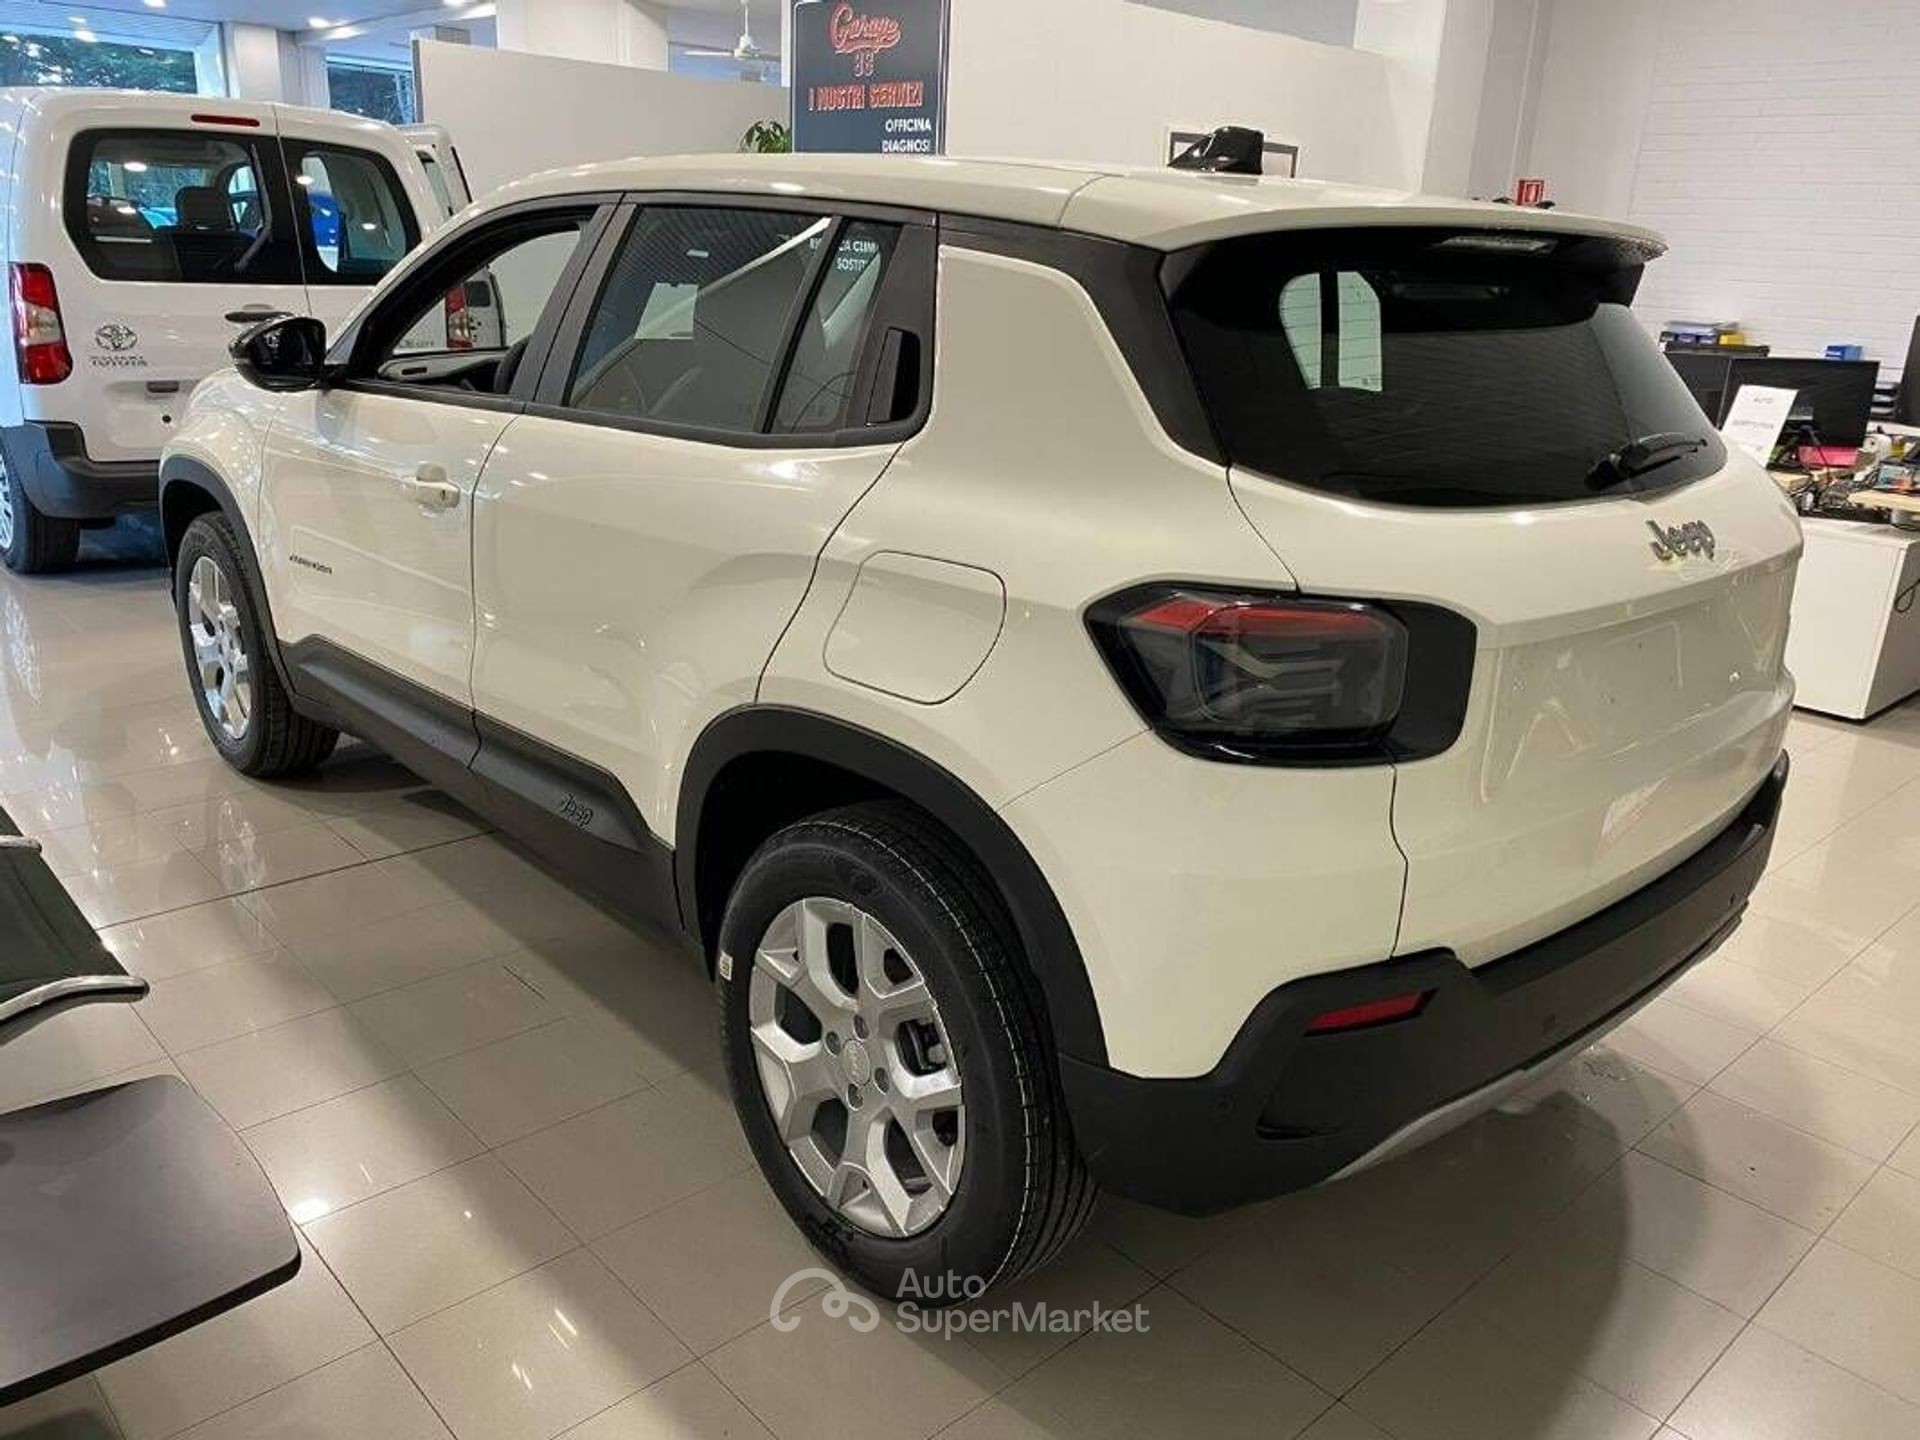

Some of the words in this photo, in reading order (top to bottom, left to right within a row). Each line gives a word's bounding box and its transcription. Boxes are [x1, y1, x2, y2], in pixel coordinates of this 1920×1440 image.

[885, 118, 932, 133] OFFICINA
[881, 139, 931, 153] DIAGNOSI
[1645, 519, 1716, 562] Jeep
